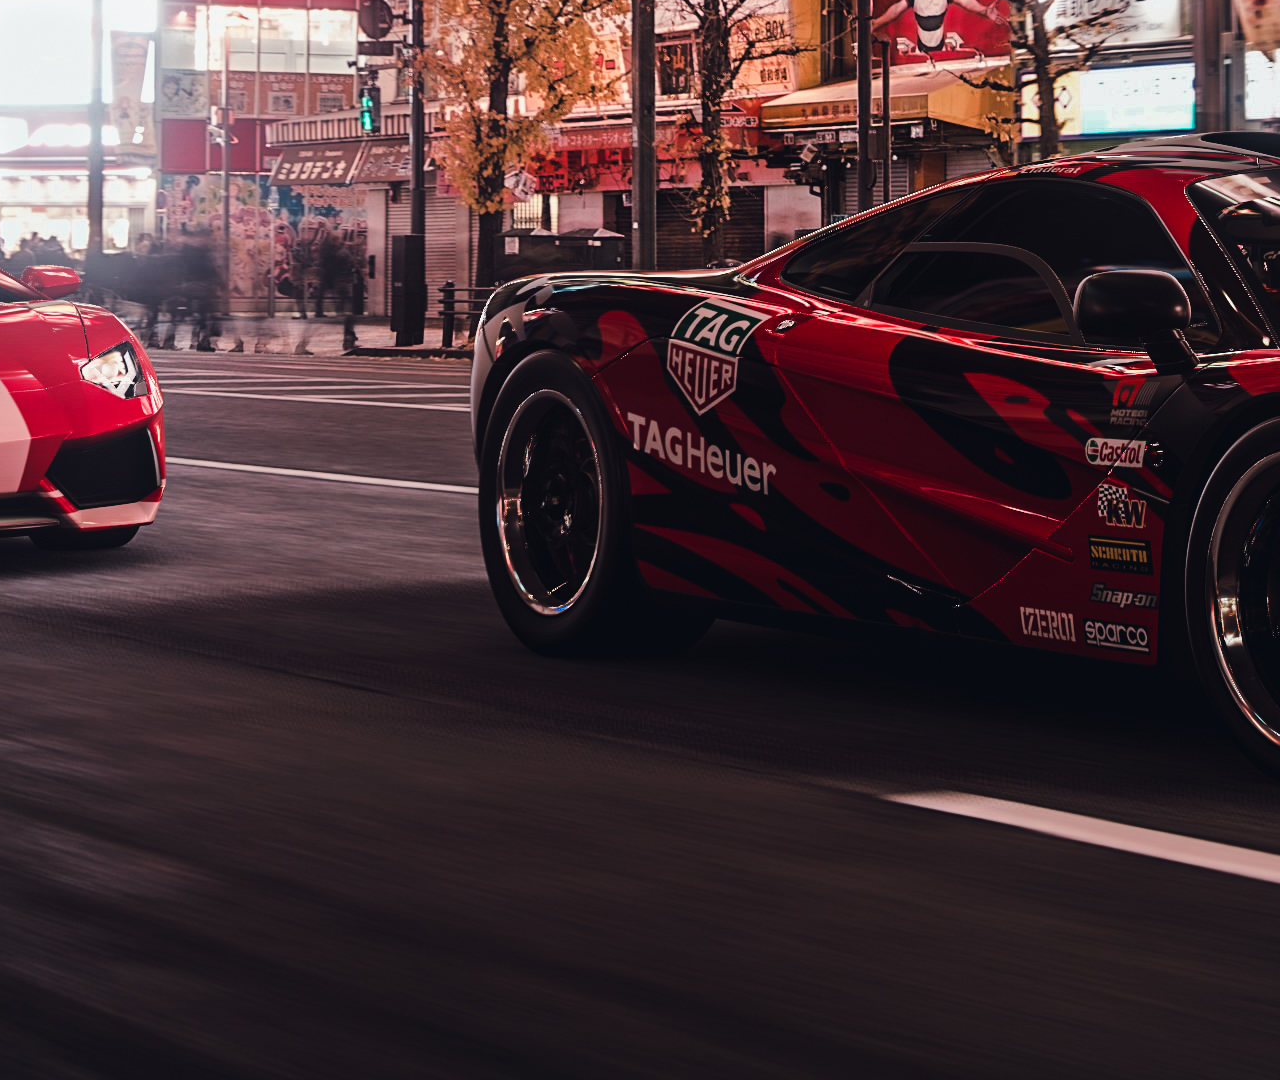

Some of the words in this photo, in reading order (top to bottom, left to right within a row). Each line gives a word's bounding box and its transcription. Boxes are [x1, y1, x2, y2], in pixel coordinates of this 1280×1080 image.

[684, 306, 751, 352] TAG
[671, 347, 734, 406] HEUER
[1099, 441, 1142, 465] Castrol
[1105, 498, 1147, 529] KW
[1091, 583, 1158, 608] Snap-on
[1085, 621, 1148, 646] sparco
